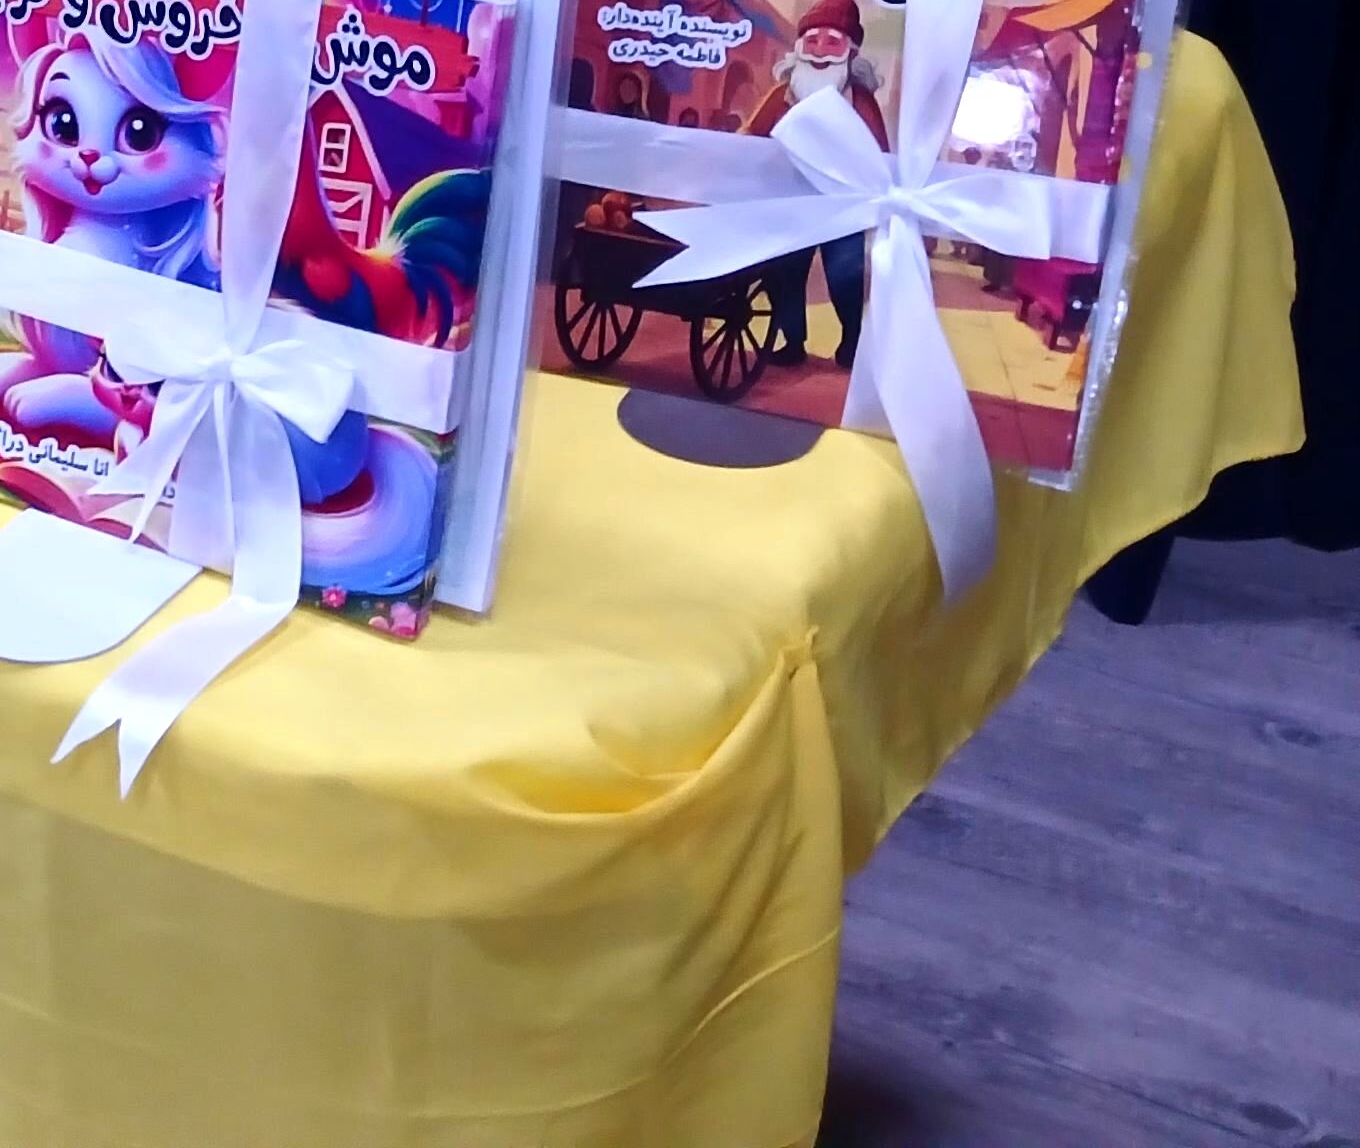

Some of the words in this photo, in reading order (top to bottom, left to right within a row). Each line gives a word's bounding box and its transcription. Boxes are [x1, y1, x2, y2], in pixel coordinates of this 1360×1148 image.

[680, 18, 748, 43] نویسنده
[310, 10, 434, 94] موش
[613, 41, 669, 62] حیدری
[677, 45, 721, 64] فاطمه
[30, 444, 88, 472] سلیمانی
